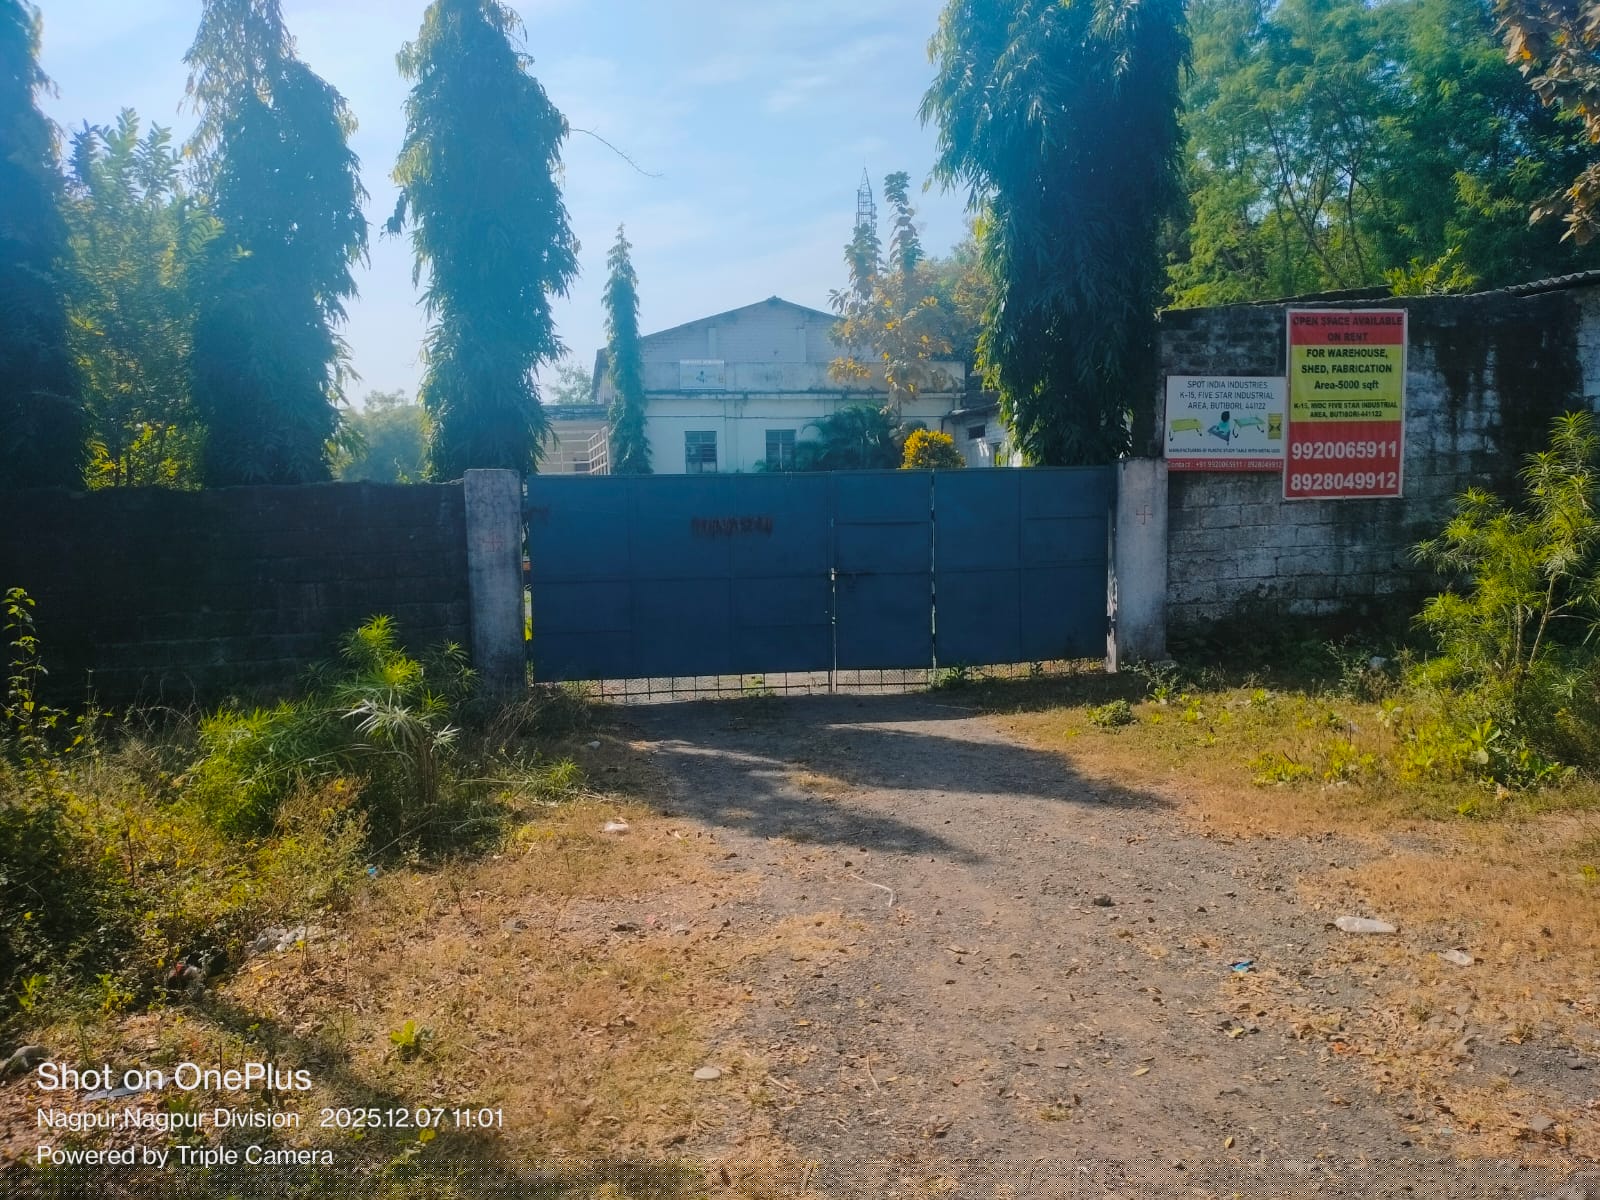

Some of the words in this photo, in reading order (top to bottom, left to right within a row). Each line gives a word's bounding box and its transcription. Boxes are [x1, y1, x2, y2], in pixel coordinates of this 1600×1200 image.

[1293, 316, 1318, 325] OPEN
[1321, 316, 1350, 325] SPACE
[1352, 316, 1402, 325] AVAILABLE
[1327, 332, 1341, 342] ON
[1344, 332, 1368, 341] RENT
[1306, 348, 1325, 358] FOR
[1327, 348, 1388, 359] WAREHOUSE,
[1301, 364, 1329, 375] SHED,
[1332, 364, 1392, 373] FABRICATION
[1187, 380, 1205, 389] SPOT
[1206, 380, 1225, 389] INDIA
[1228, 381, 1268, 389] INDUSTRIES
[1314, 380, 1360, 389] Area-5000
[1362, 380, 1379, 390] sqft
[1179, 392, 1196, 400] K-15,
[1187, 402, 1209, 410] AREA,
[1292, 441, 1396, 459] 9920065911
[1290, 472, 1396, 490] 8928049912
